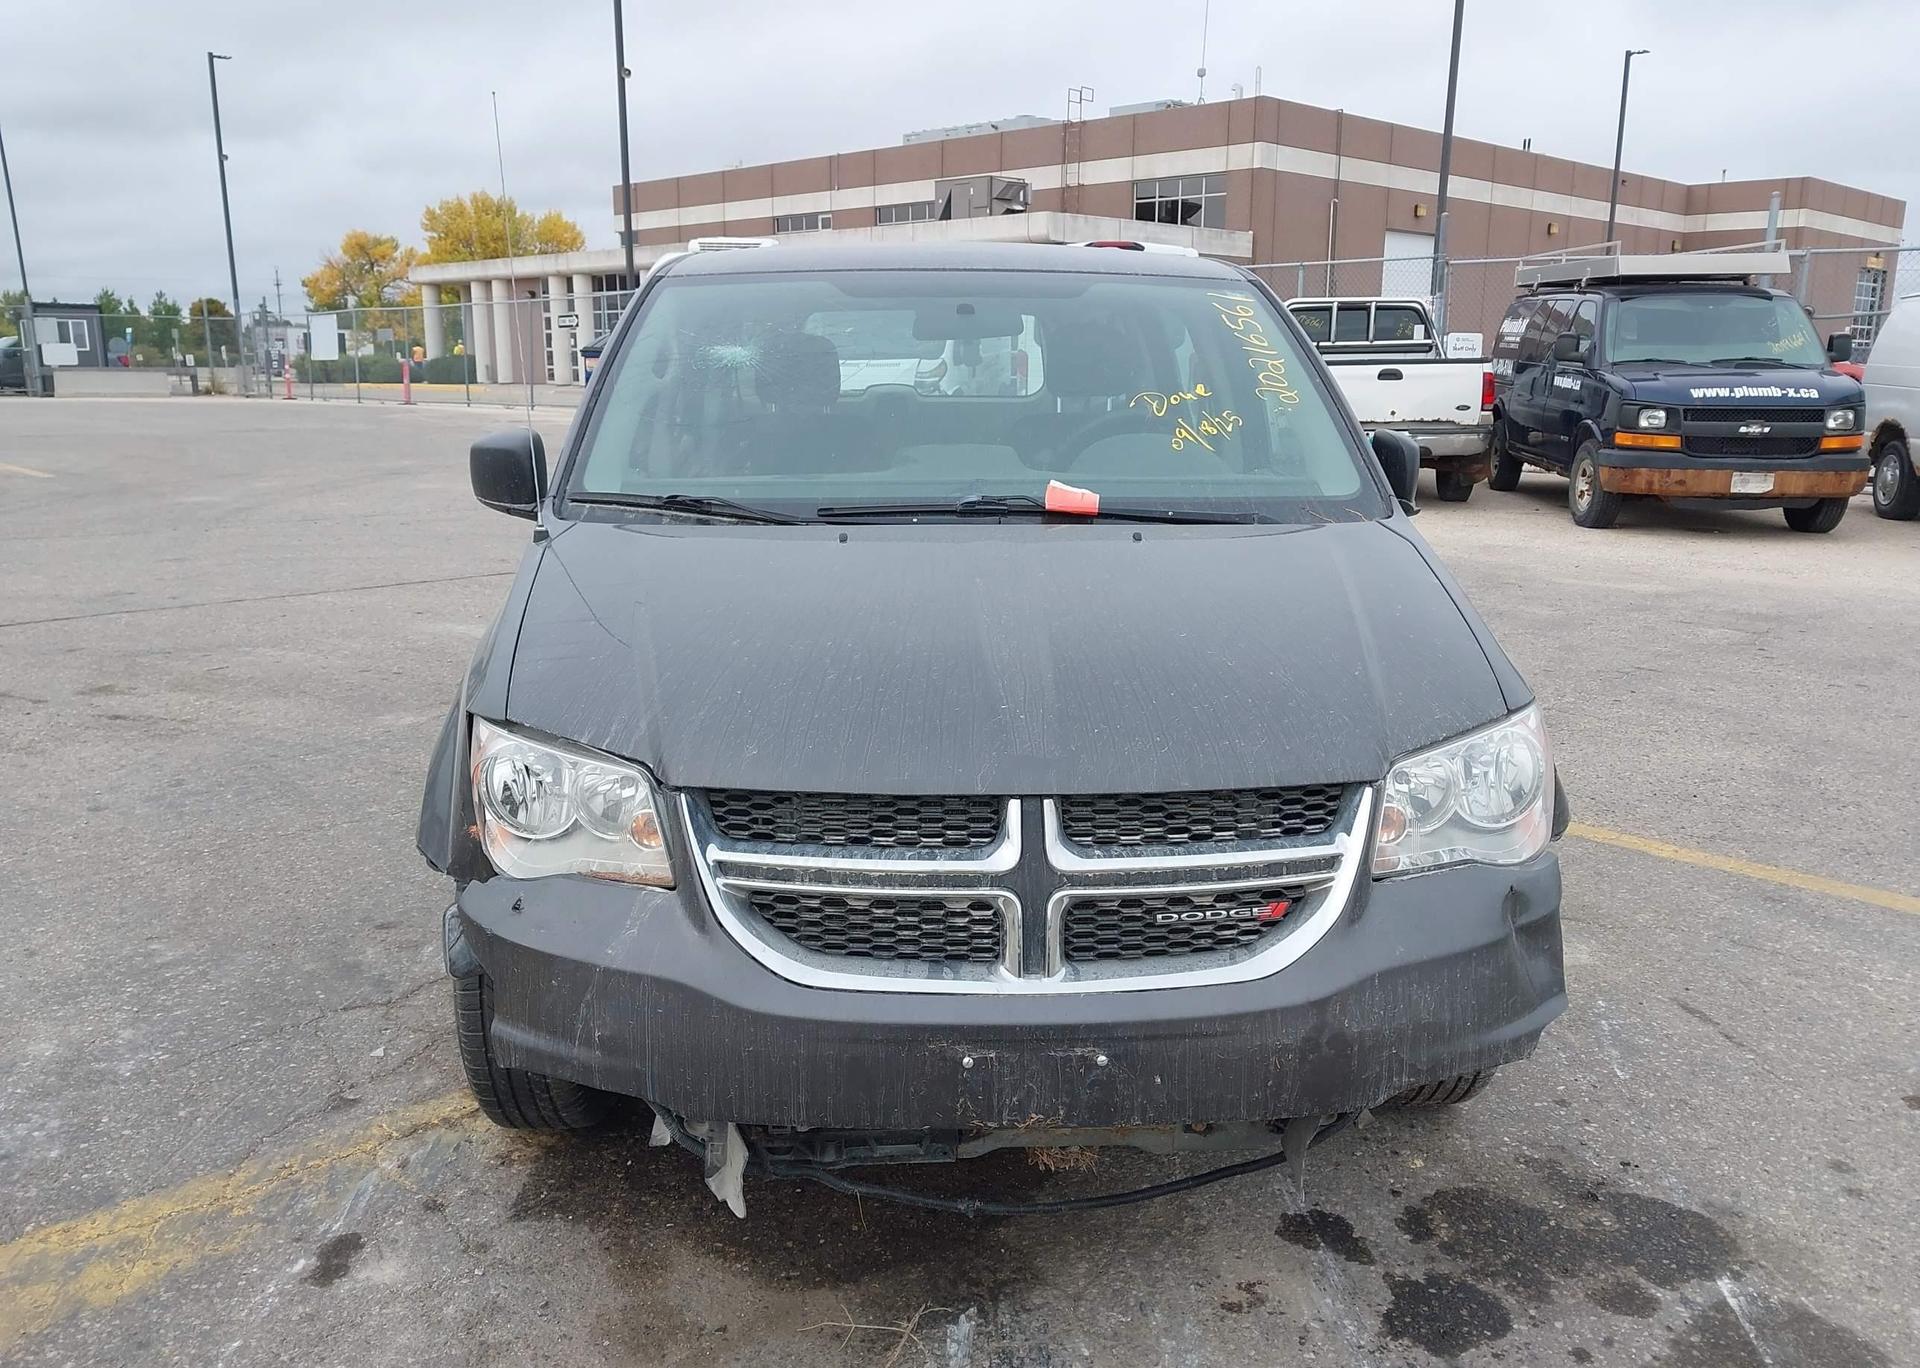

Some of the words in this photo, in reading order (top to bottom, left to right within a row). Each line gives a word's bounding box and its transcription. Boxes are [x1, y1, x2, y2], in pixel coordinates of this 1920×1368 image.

[1206, 292, 1299, 404] 20216561
[1129, 384, 1213, 416] Done
[1690, 386, 1819, 399] www.plumb-x.ca
[1156, 906, 1272, 923] DODGE
